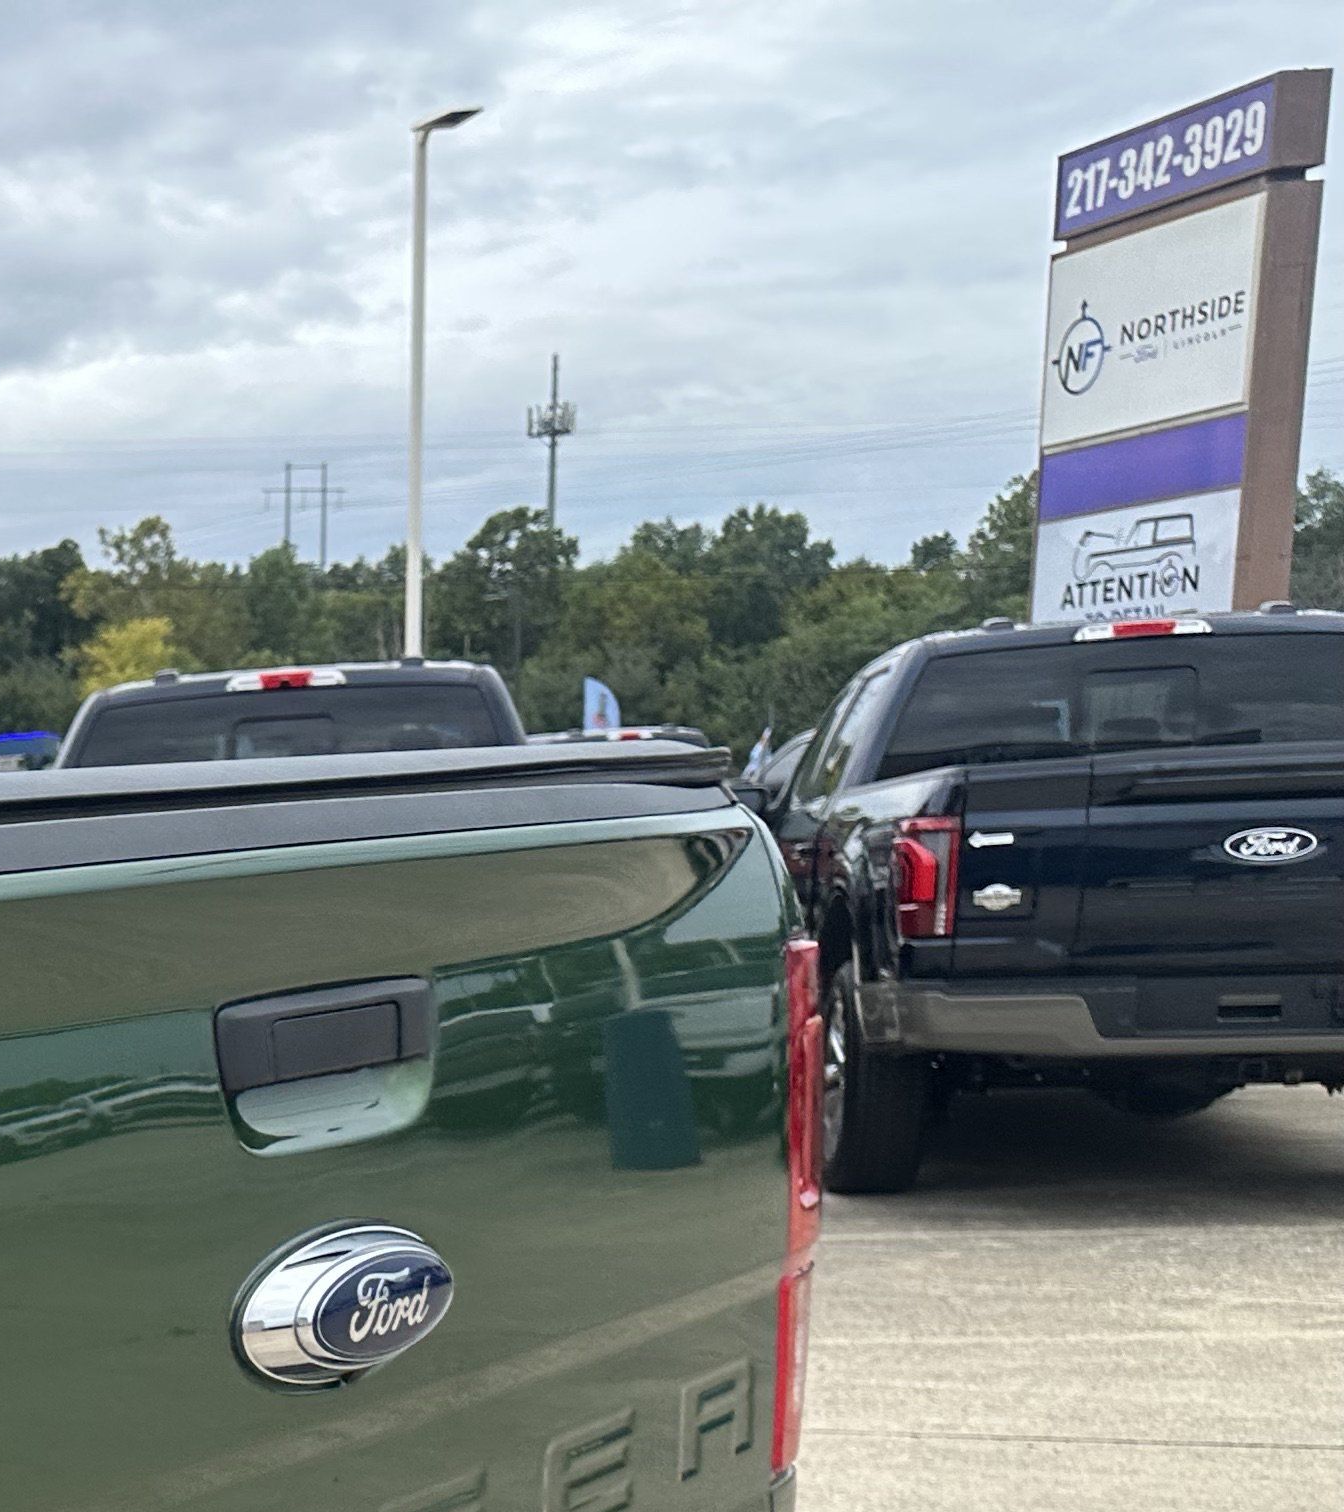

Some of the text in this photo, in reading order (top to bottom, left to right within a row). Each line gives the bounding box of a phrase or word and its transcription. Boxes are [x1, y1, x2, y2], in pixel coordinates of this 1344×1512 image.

[1065, 100, 1268, 219] 217-342-3929
[1120, 290, 1247, 346] NORTHSIDE
[1060, 564, 1201, 611] ATTENTION
[1238, 832, 1302, 857] Ford
[349, 1266, 432, 1343] Ford
